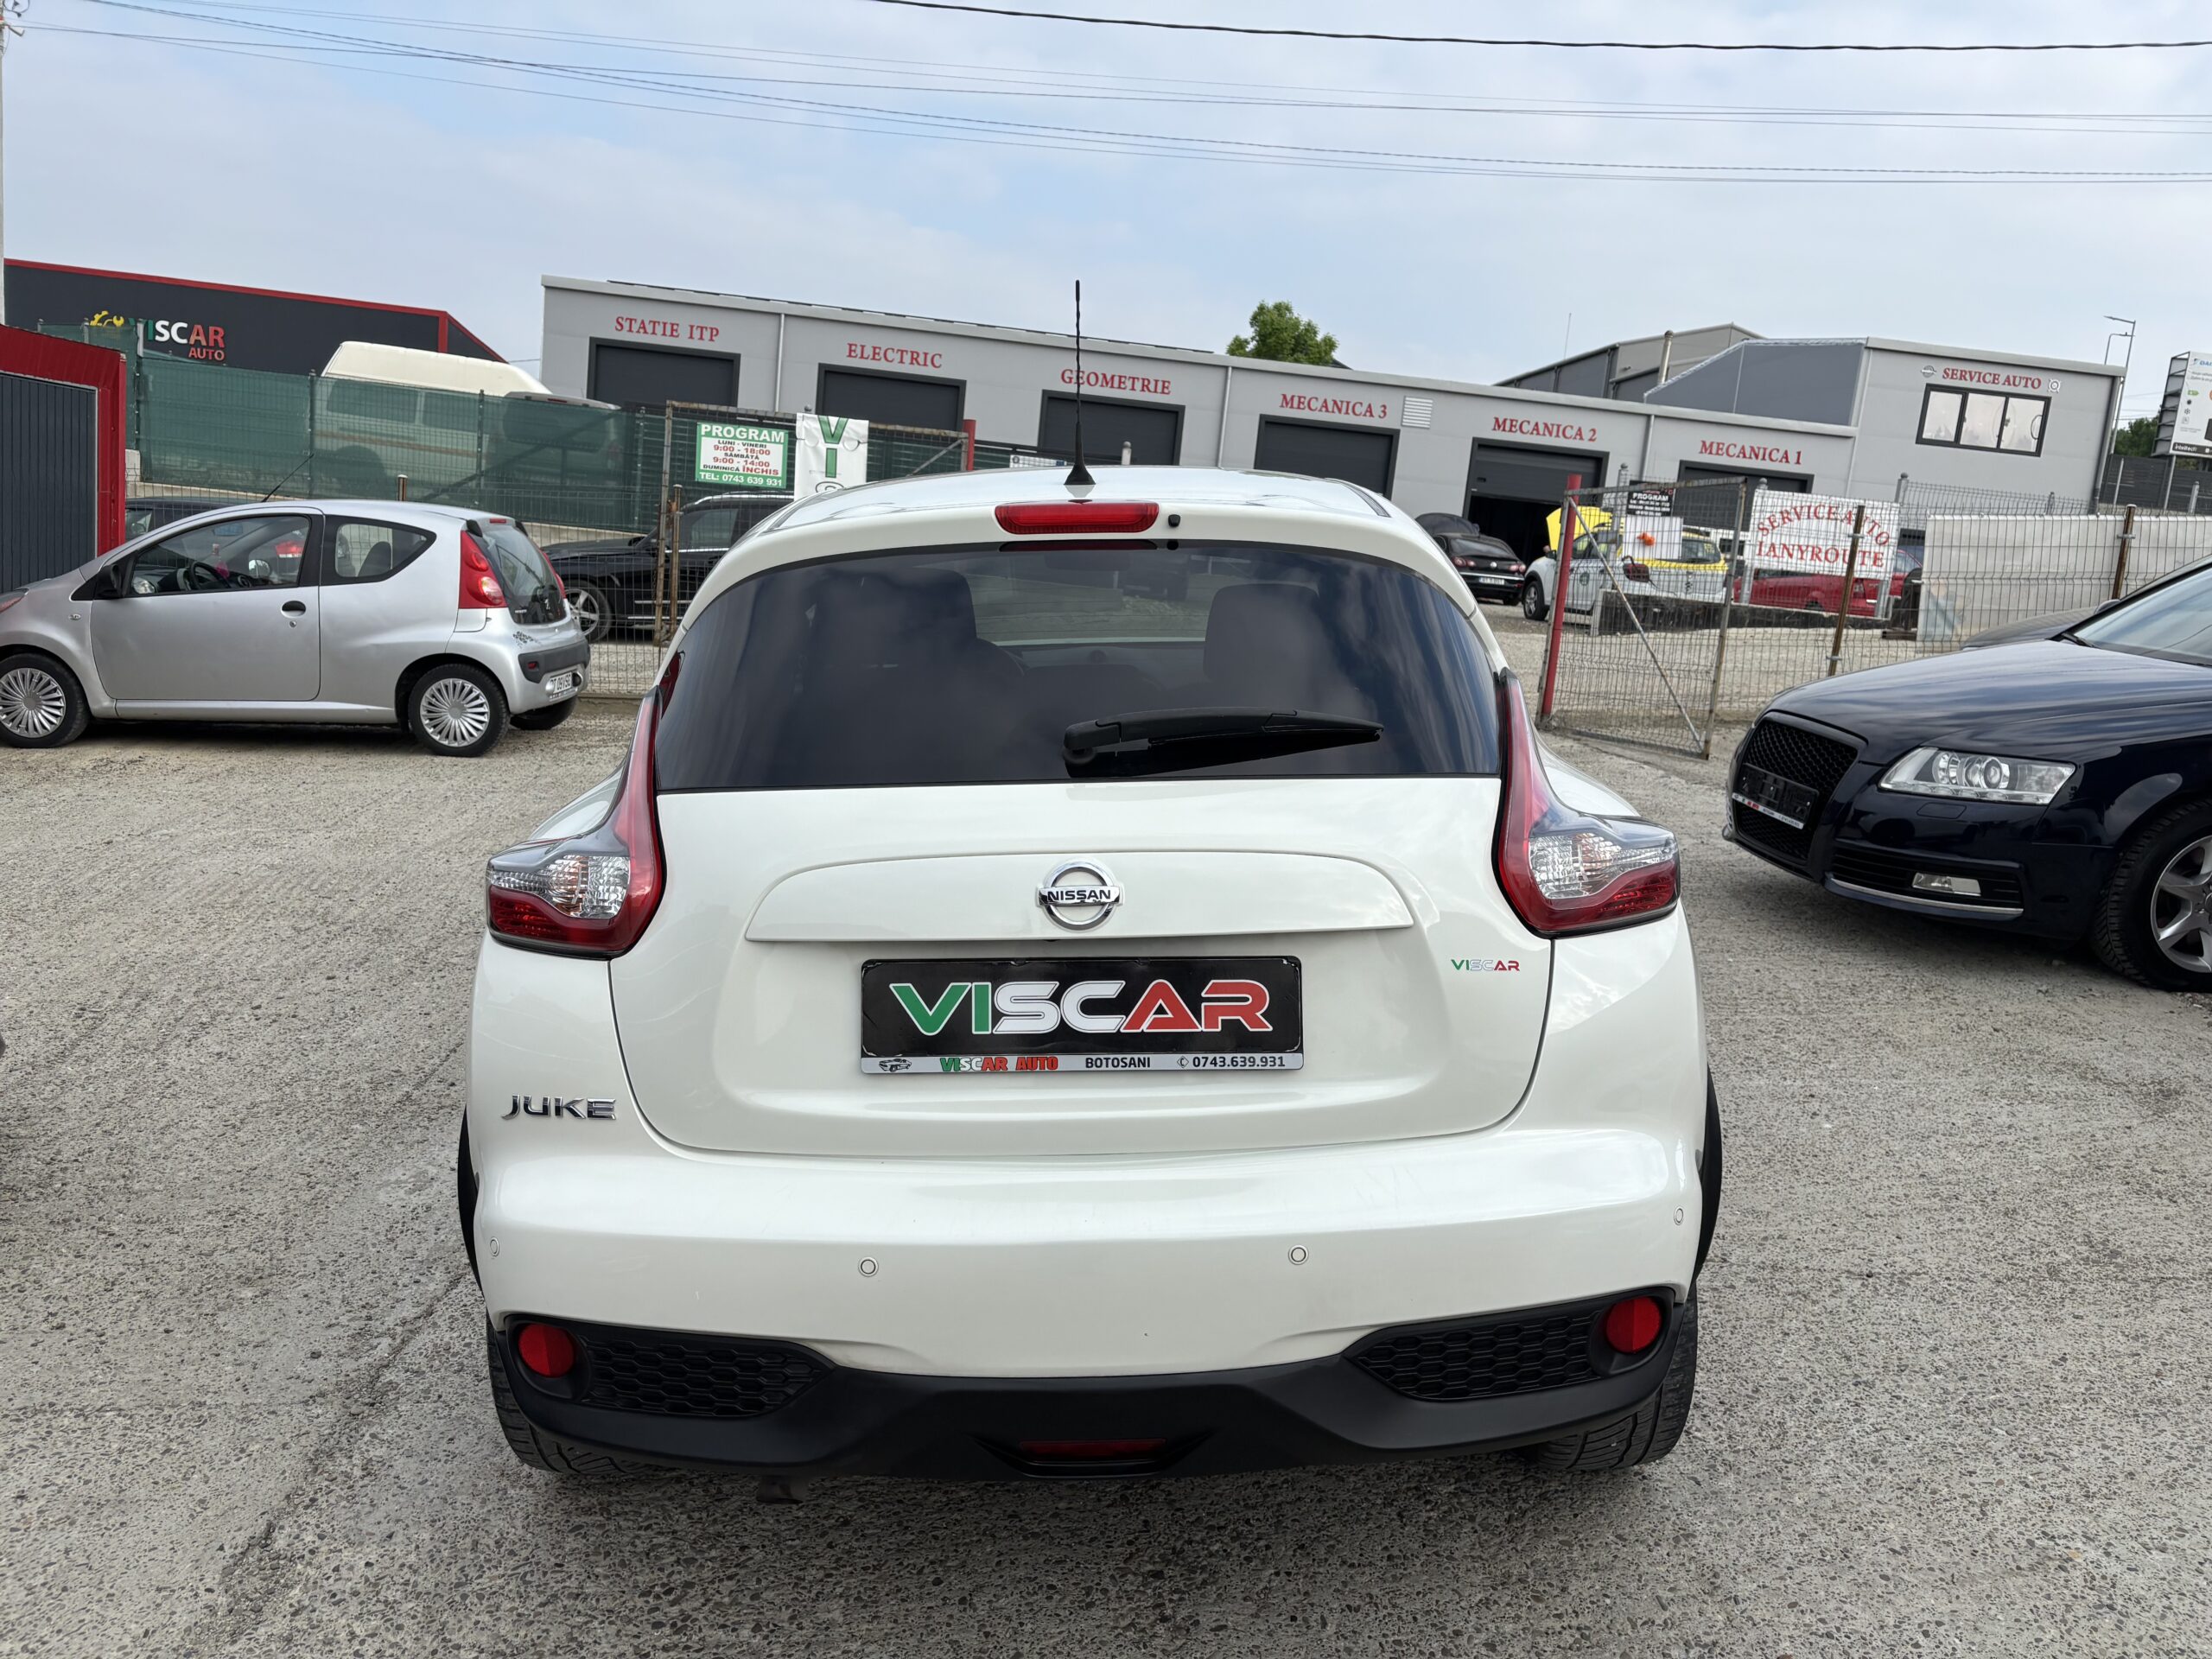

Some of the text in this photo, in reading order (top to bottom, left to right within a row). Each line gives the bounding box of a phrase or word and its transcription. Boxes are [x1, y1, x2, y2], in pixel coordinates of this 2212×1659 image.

[615, 316, 720, 341] STATIE ITP
[188, 347, 225, 361] AUTO
[846, 343, 942, 368] ELECTRIC
[1060, 368, 1172, 395] GEOMETRIE
[1942, 367, 2042, 389] SERVICE AUTO
[1280, 393, 1388, 419] MECANICA 3
[701, 423, 785, 443] PROGRAM
[1492, 416, 1597, 442] MECANICA 2
[1700, 440, 1802, 465] MECANICA 1
[699, 472, 719, 480] TEL:
[722, 474, 744, 483] 0743
[766, 478, 782, 486] 931
[1632, 492, 1669, 501] PROGRAM
[1758, 504, 1891, 546] SERVICE ATO
[1047, 889, 1111, 900] NISSAN
[1450, 958, 1521, 971] VISCAR
[888, 978, 1273, 1036] VISCAR
[939, 1056, 1286, 1071] VISCAR AUTO BOTOSANI 0743.639.931
[500, 1094, 617, 1121] JUKE
